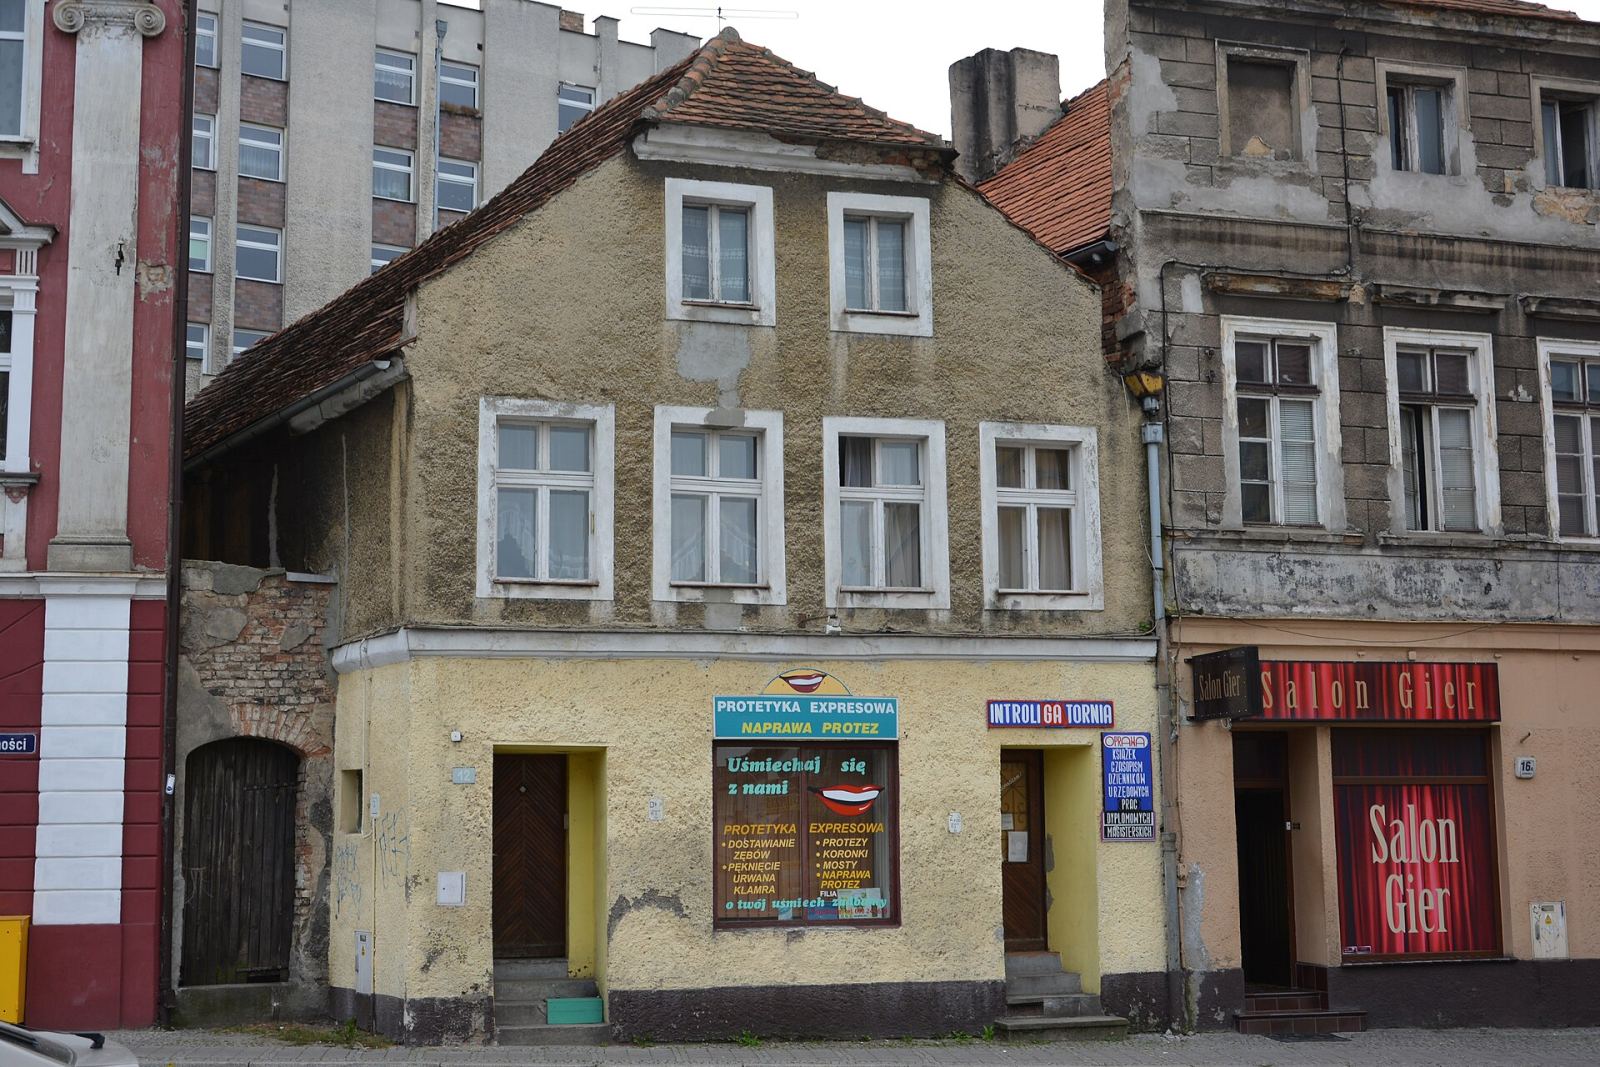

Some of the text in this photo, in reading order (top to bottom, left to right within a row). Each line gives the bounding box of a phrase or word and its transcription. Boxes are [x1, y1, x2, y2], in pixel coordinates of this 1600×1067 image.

[1199, 670, 1241, 701] Salon Gier
[1260, 671, 1477, 710] Salon Gier
[717, 701, 895, 714] PROTETYKA EXPRESOWA
[741, 722, 880, 735] NAPRAWA PROTEZ
[0, 737, 27, 751] ości
[1105, 736, 1145, 747] OPRAWA
[727, 756, 867, 775] Uśmiechaj się
[1110, 761, 1143, 773] CZASOPISM
[728, 780, 789, 795] z nami
[1121, 798, 1138, 810] PRAC
[1106, 812, 1151, 825] DYPLOMOWYCH
[723, 822, 885, 835] PROTETYKA EXPRESOWA
[1369, 804, 1459, 864] Salon
[727, 838, 796, 849] DOSTAWIANIE
[822, 837, 868, 848] PROTEZY
[733, 850, 771, 861] ZĘBÓW
[822, 849, 868, 859] KORONKI
[727, 861, 781, 873] PĘKNIĘCIE
[822, 860, 858, 870] MOSTY
[732, 874, 776, 884] URWANA
[822, 870, 871, 880] NAPRAWA
[733, 885, 776, 895] KLAMRA
[820, 880, 861, 889] PROTEZ
[819, 890, 837, 898] FILIA
[725, 901, 734, 910] o
[737, 898, 767, 912] twój
[771, 896, 825, 909] uśmiech
[1385, 873, 1451, 934] Gier
